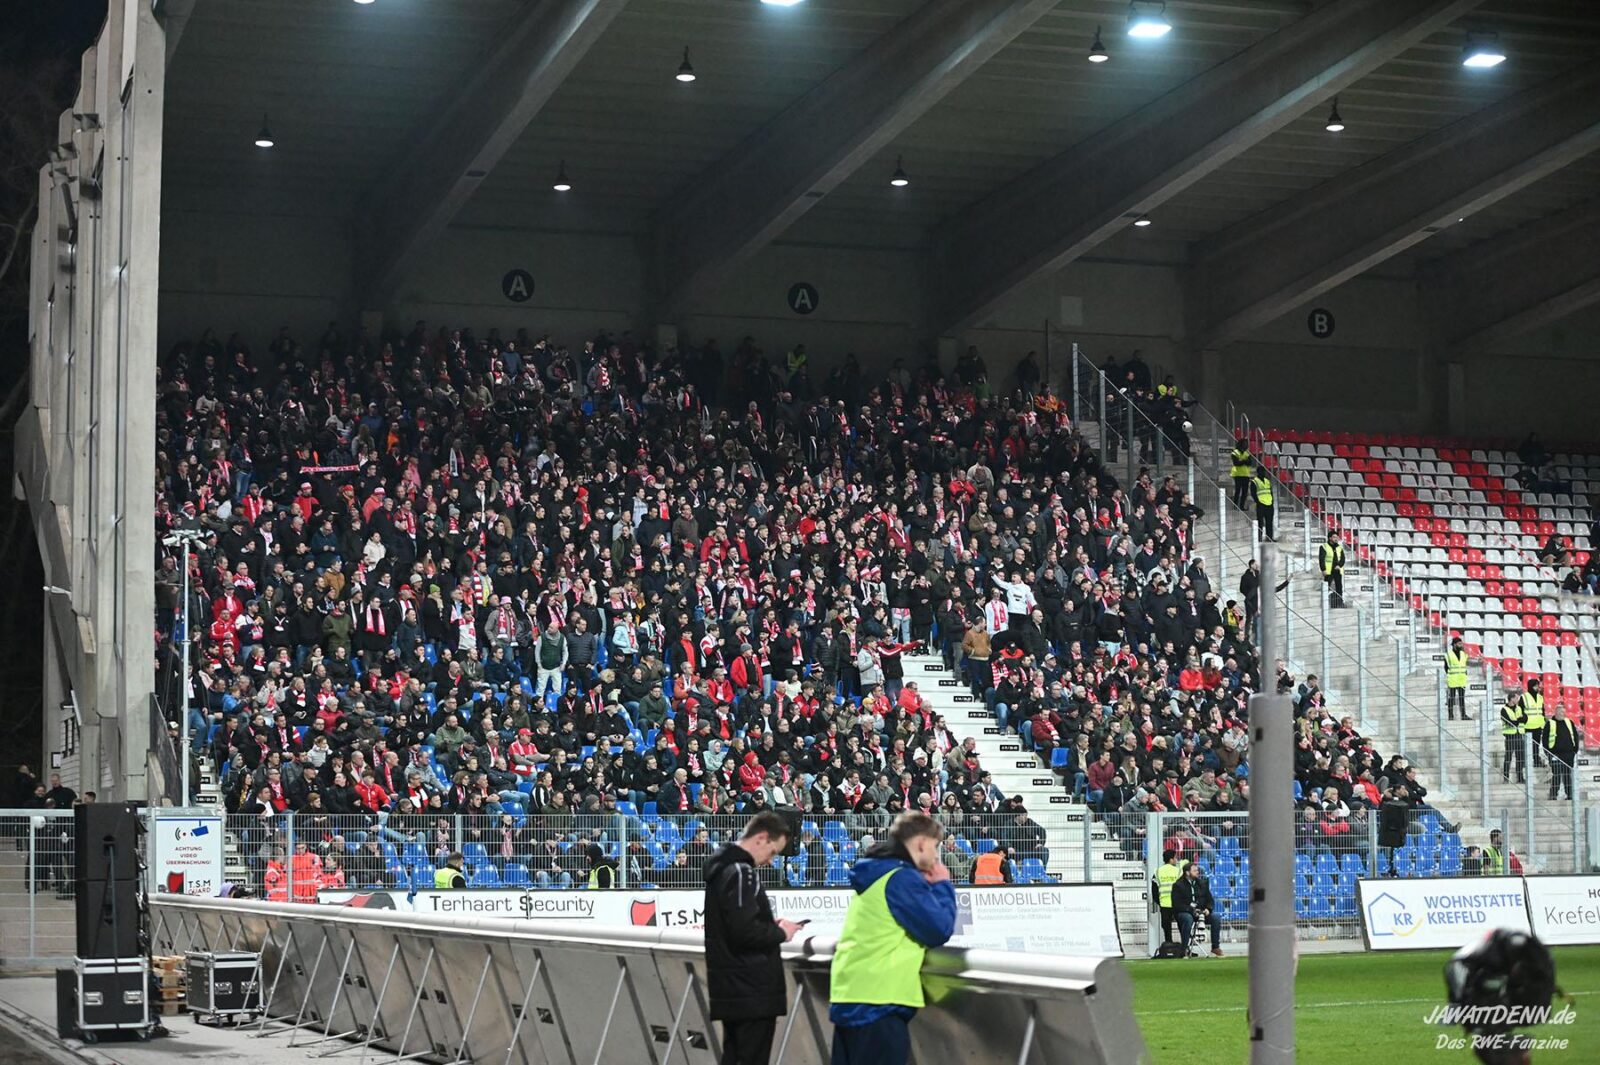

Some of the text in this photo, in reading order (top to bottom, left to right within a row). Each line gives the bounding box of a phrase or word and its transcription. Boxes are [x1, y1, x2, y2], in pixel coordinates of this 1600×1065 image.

[509, 275, 528, 297] A
[794, 288, 813, 310] A
[1315, 313, 1329, 333] B
[429, 895, 595, 916] Terhaart Security
[975, 892, 1062, 906] IMMOBILIEN
[1424, 893, 1522, 909] WOHNSTÄTTE
[1393, 912, 1413, 926] KR
[1427, 911, 1486, 925] KREFELD
